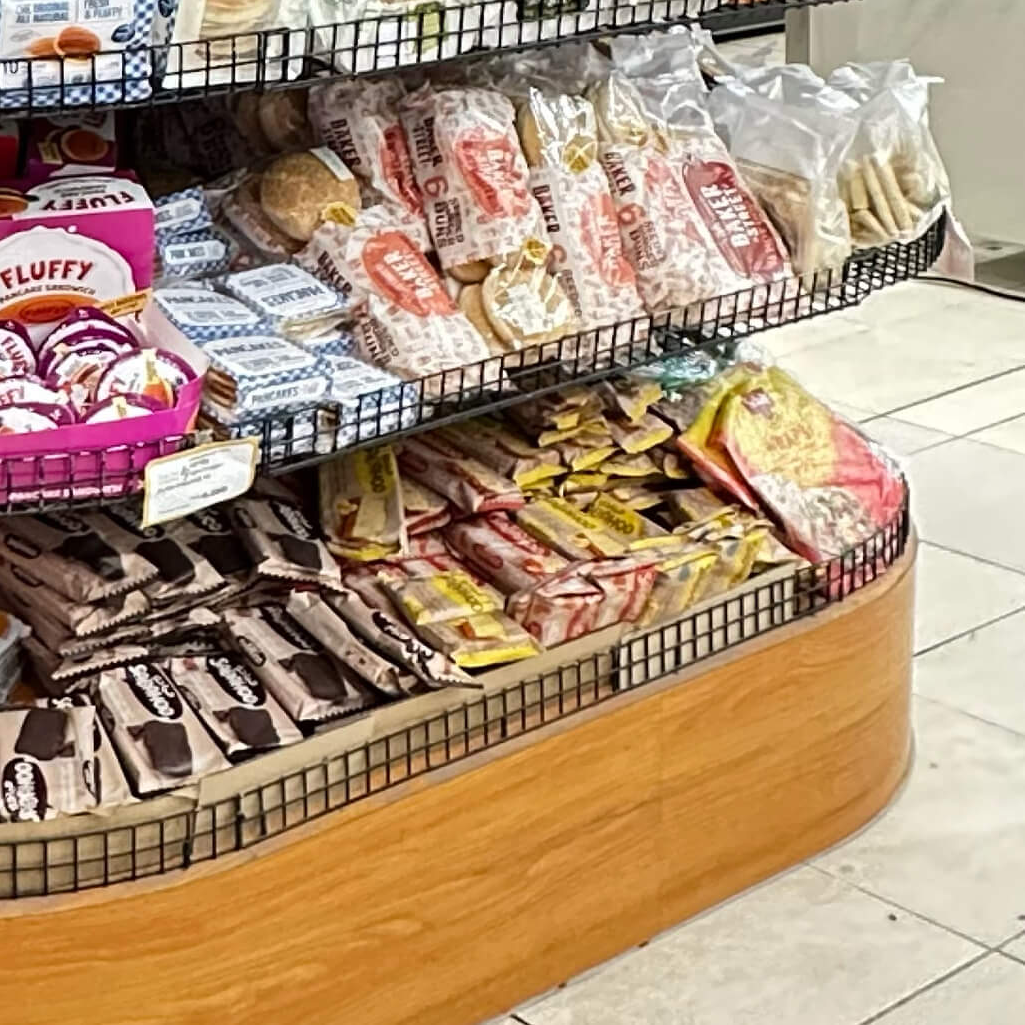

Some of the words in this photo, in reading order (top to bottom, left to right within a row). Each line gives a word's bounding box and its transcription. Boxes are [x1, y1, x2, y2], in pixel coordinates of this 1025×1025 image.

[424, 176, 450, 199] 6
[604, 151, 636, 197] BAKER
[41, 191, 136, 211] FLUFFY
[532, 184, 560, 234] BAKER
[700, 184, 751, 248] BAKER
[317, 250, 353, 294] BAKER
[45, 284, 96, 296] SANDWICH
[251, 387, 300, 405] PANCAKES
